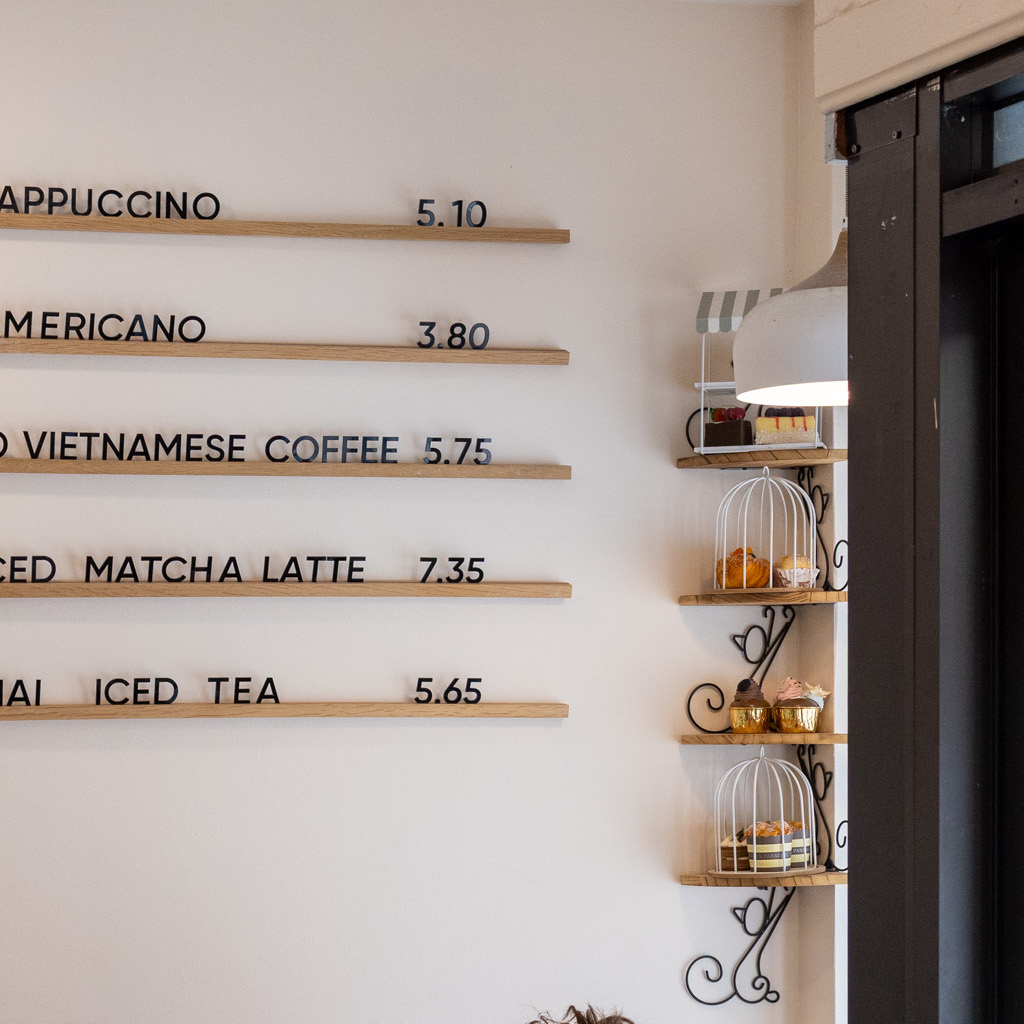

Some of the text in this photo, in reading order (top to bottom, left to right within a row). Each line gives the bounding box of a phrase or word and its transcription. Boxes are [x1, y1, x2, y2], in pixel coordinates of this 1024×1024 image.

[417, 199, 486, 228] 5.10
[417, 322, 489, 350] 3.80
[23, 431, 245, 462] VIETNAMESE
[265, 436, 398, 464] COFFEE
[423, 438, 491, 465] 5.75
[85, 556, 244, 583] MATCHA
[261, 556, 365, 583] LATTE
[419, 558, 484, 584] 7.35
[95, 678, 178, 705] ICED
[208, 677, 280, 704] TEA
[415, 678, 481, 704] 5.65
